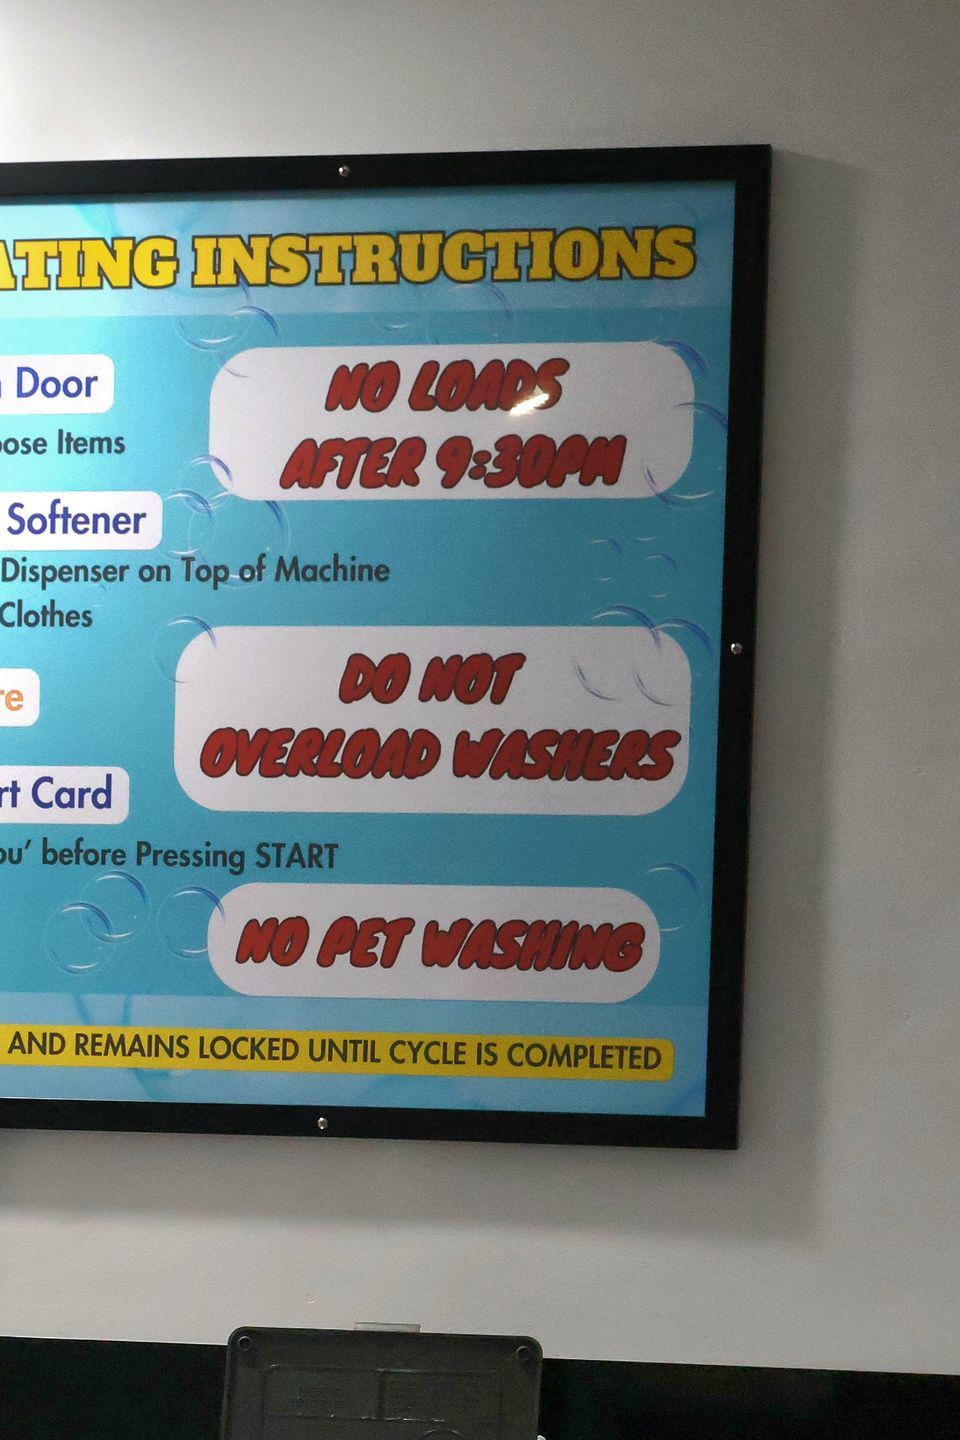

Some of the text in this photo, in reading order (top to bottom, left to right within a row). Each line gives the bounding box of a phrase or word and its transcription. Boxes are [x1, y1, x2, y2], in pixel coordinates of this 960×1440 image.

[192, 226, 695, 288] INSTRUCTIONS
[17, 365, 98, 399] Door
[325, 358, 569, 412] NO LOADS
[58, 428, 124, 455] Items
[280, 434, 627, 490] AFTER 9:30PM
[8, 499, 146, 536] Softener
[2, 557, 129, 590] Dispenser
[139, 564, 171, 583] on
[182, 559, 230, 590] Top
[240, 555, 266, 583] of
[275, 556, 389, 583] Machine
[0, 599, 93, 628] Clothes
[339, 652, 526, 705] DO NOT
[200, 726, 681, 781] OVERLOAD WASHERS
[32, 774, 112, 809] Card
[43, 839, 125, 866] before
[137, 843, 245, 874] Pressing
[256, 843, 339, 869] START
[236, 916, 645, 972] NO PET WASHING
[8, 1031, 66, 1056] AND
[74, 1032, 190, 1060] REMAINS
[199, 1036, 299, 1062] LOCKED
[309, 1039, 380, 1064] UNTIL
[389, 1040, 466, 1066] CYCLE
[476, 1042, 498, 1067] IS
[508, 1042, 662, 1071] COMPLETED
